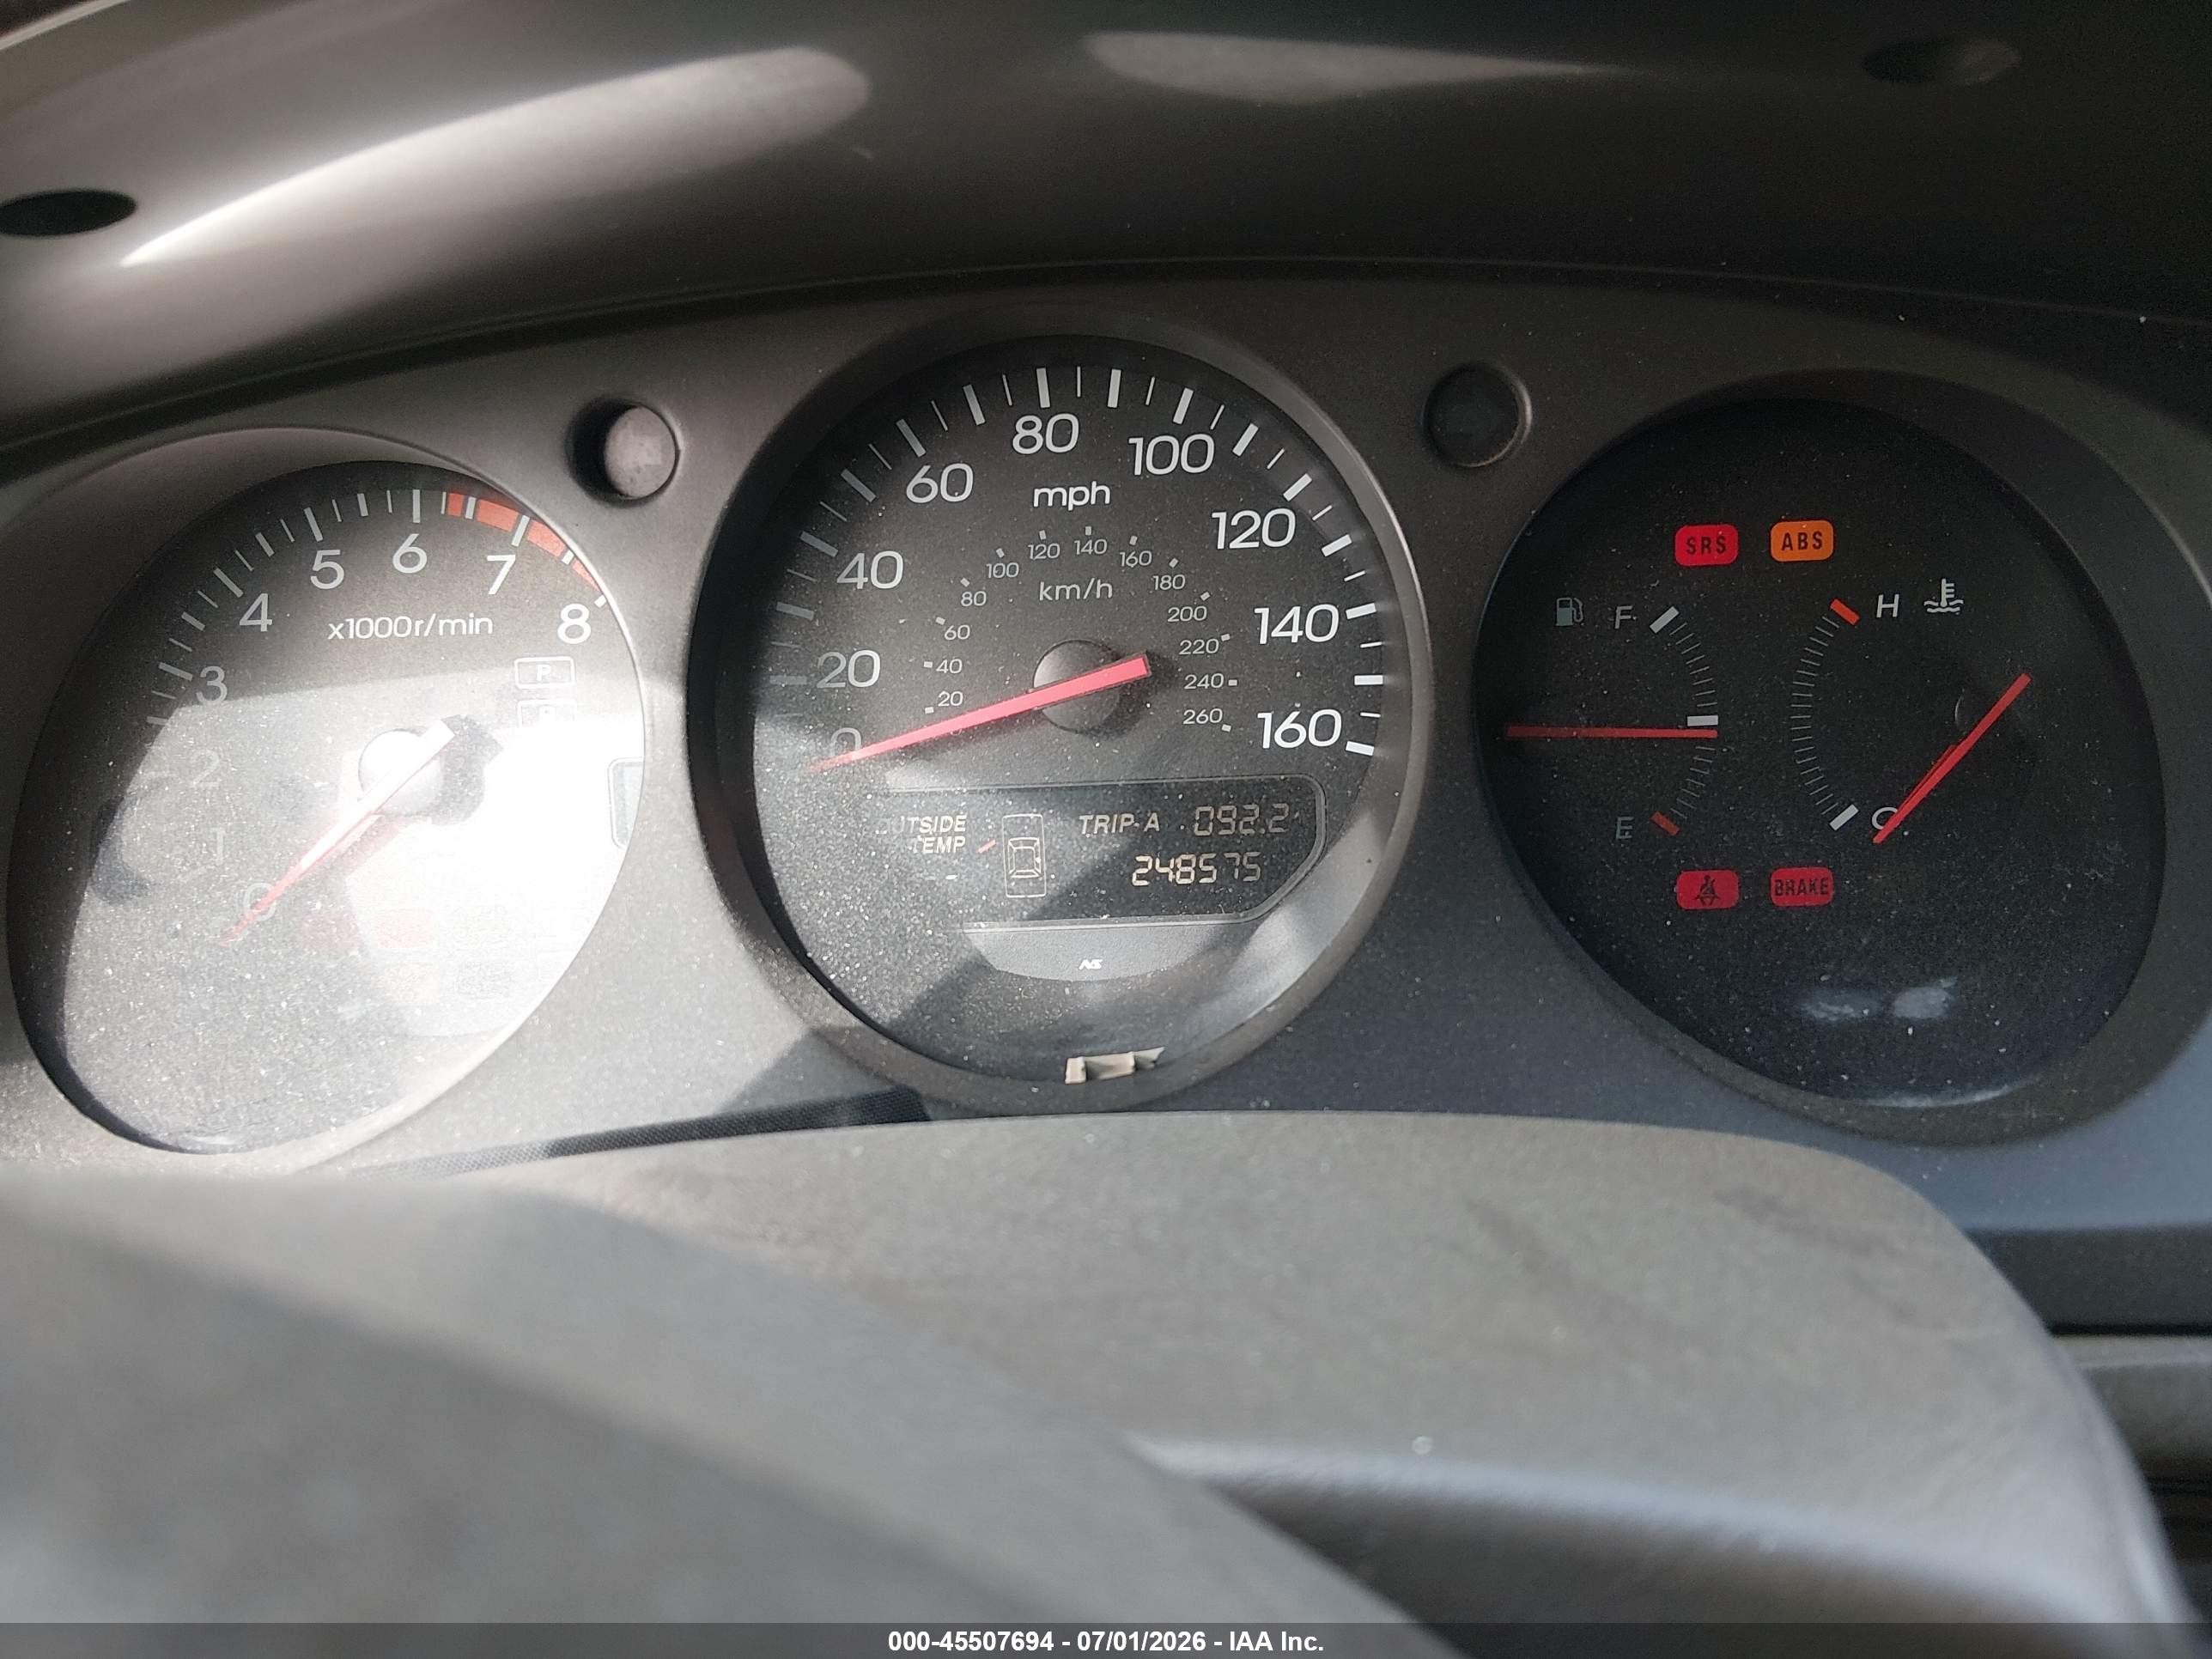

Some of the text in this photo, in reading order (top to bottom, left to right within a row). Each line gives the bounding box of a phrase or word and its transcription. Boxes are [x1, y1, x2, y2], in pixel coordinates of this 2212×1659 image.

[1012, 413, 1079, 454] 80
[1128, 434, 1214, 476] 100
[907, 463, 974, 504] 60
[1033, 481, 1111, 511] mph
[1211, 508, 1297, 550] 120
[1781, 531, 1824, 551] ABS
[393, 534, 427, 574] 6
[1028, 543, 1060, 559] 120
[1074, 538, 1107, 556] 140
[1686, 536, 1726, 555] SRS
[311, 549, 345, 589] 5
[837, 550, 904, 590] 40
[987, 562, 1019, 579] 100
[1120, 550, 1152, 567] 160
[486, 555, 516, 595] 7
[1153, 574, 1186, 590] 180
[960, 591, 987, 606] 80
[1039, 578, 1113, 600] km/h
[240, 594, 273, 632] 4
[1167, 605, 1207, 623] 200
[1614, 605, 1632, 629] F
[1875, 594, 1900, 618] H
[327, 612, 494, 641] x1000r/min
[558, 605, 591, 644] 8
[944, 624, 970, 640] 60
[1255, 604, 1339, 644] 140
[1179, 639, 1219, 654] 220
[537, 664, 551, 682] P
[817, 649, 881, 689] 20
[936, 659, 963, 674] 40
[197, 666, 228, 706] 3
[1184, 673, 1224, 689] 240
[938, 691, 963, 707] 20
[1183, 708, 1223, 725] 260
[1257, 709, 1341, 749] 160
[191, 749, 220, 788] 2
[1079, 812, 1160, 835] TRIP A
[1194, 803, 1289, 836] 092.2
[1616, 817, 1632, 839] E
[911, 836, 966, 854] TEMP
[1132, 852, 1261, 886] 248575
[1774, 877, 1829, 896] BRAKE
[244, 883, 276, 921] 0
